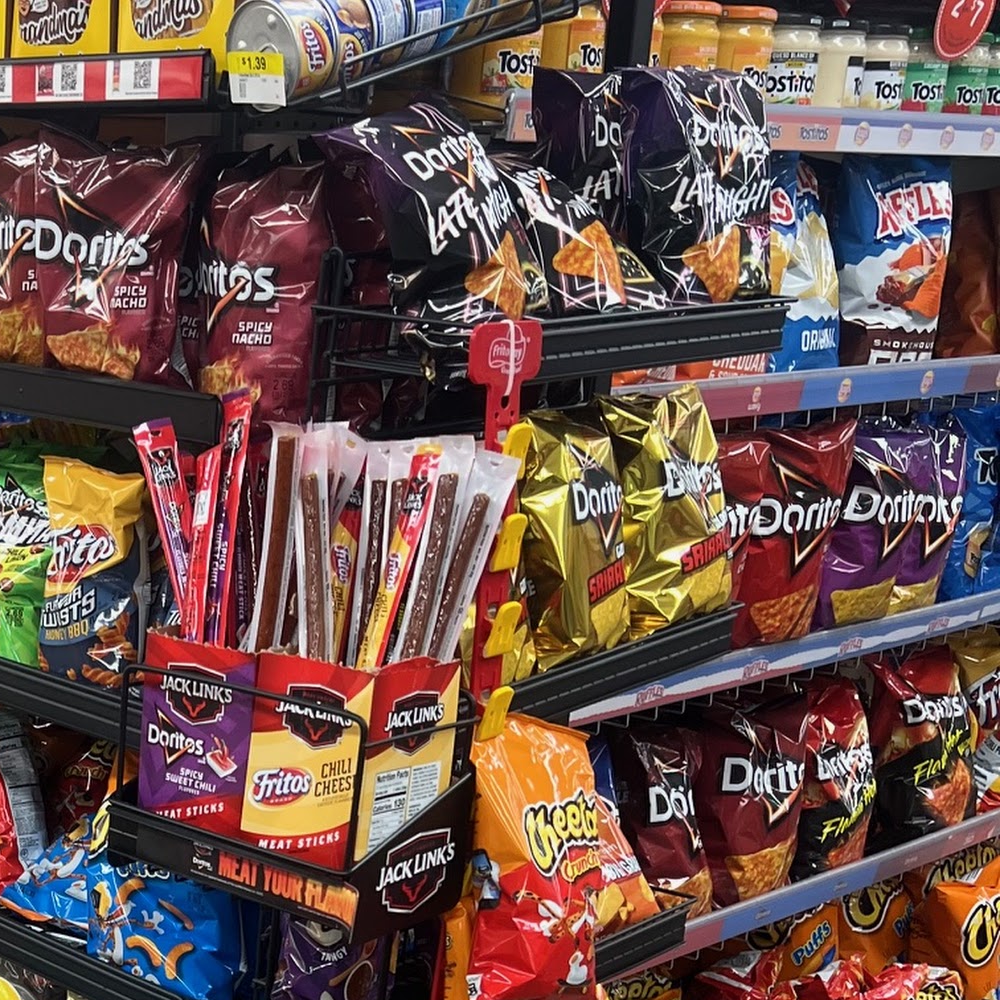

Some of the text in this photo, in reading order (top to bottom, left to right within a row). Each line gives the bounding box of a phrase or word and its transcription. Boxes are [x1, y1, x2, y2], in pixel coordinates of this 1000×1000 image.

[241, 56, 267, 71] $1.39
[35, 217, 150, 268] Doritos
[114, 284, 148, 297] SPICY
[232, 332, 273, 345] NACHO
[238, 321, 274, 334] SPICY
[160, 674, 233, 704] JACK LINK'S
[384, 702, 445, 733] JACK LINK'S
[148, 722, 205, 756] Doritos
[179, 767, 204, 780] SPICY
[321, 758, 352, 779] CHILI
[165, 772, 217, 794] SWEET CHILI
[252, 768, 313, 804] Fritos
[186, 801, 225, 817] STICKS
[258, 830, 341, 850] MEAT STICKS
[218, 852, 303, 903] MEAT YOUR
[376, 842, 456, 893] JACK LINK'S
[792, 920, 831, 966] Puffs
